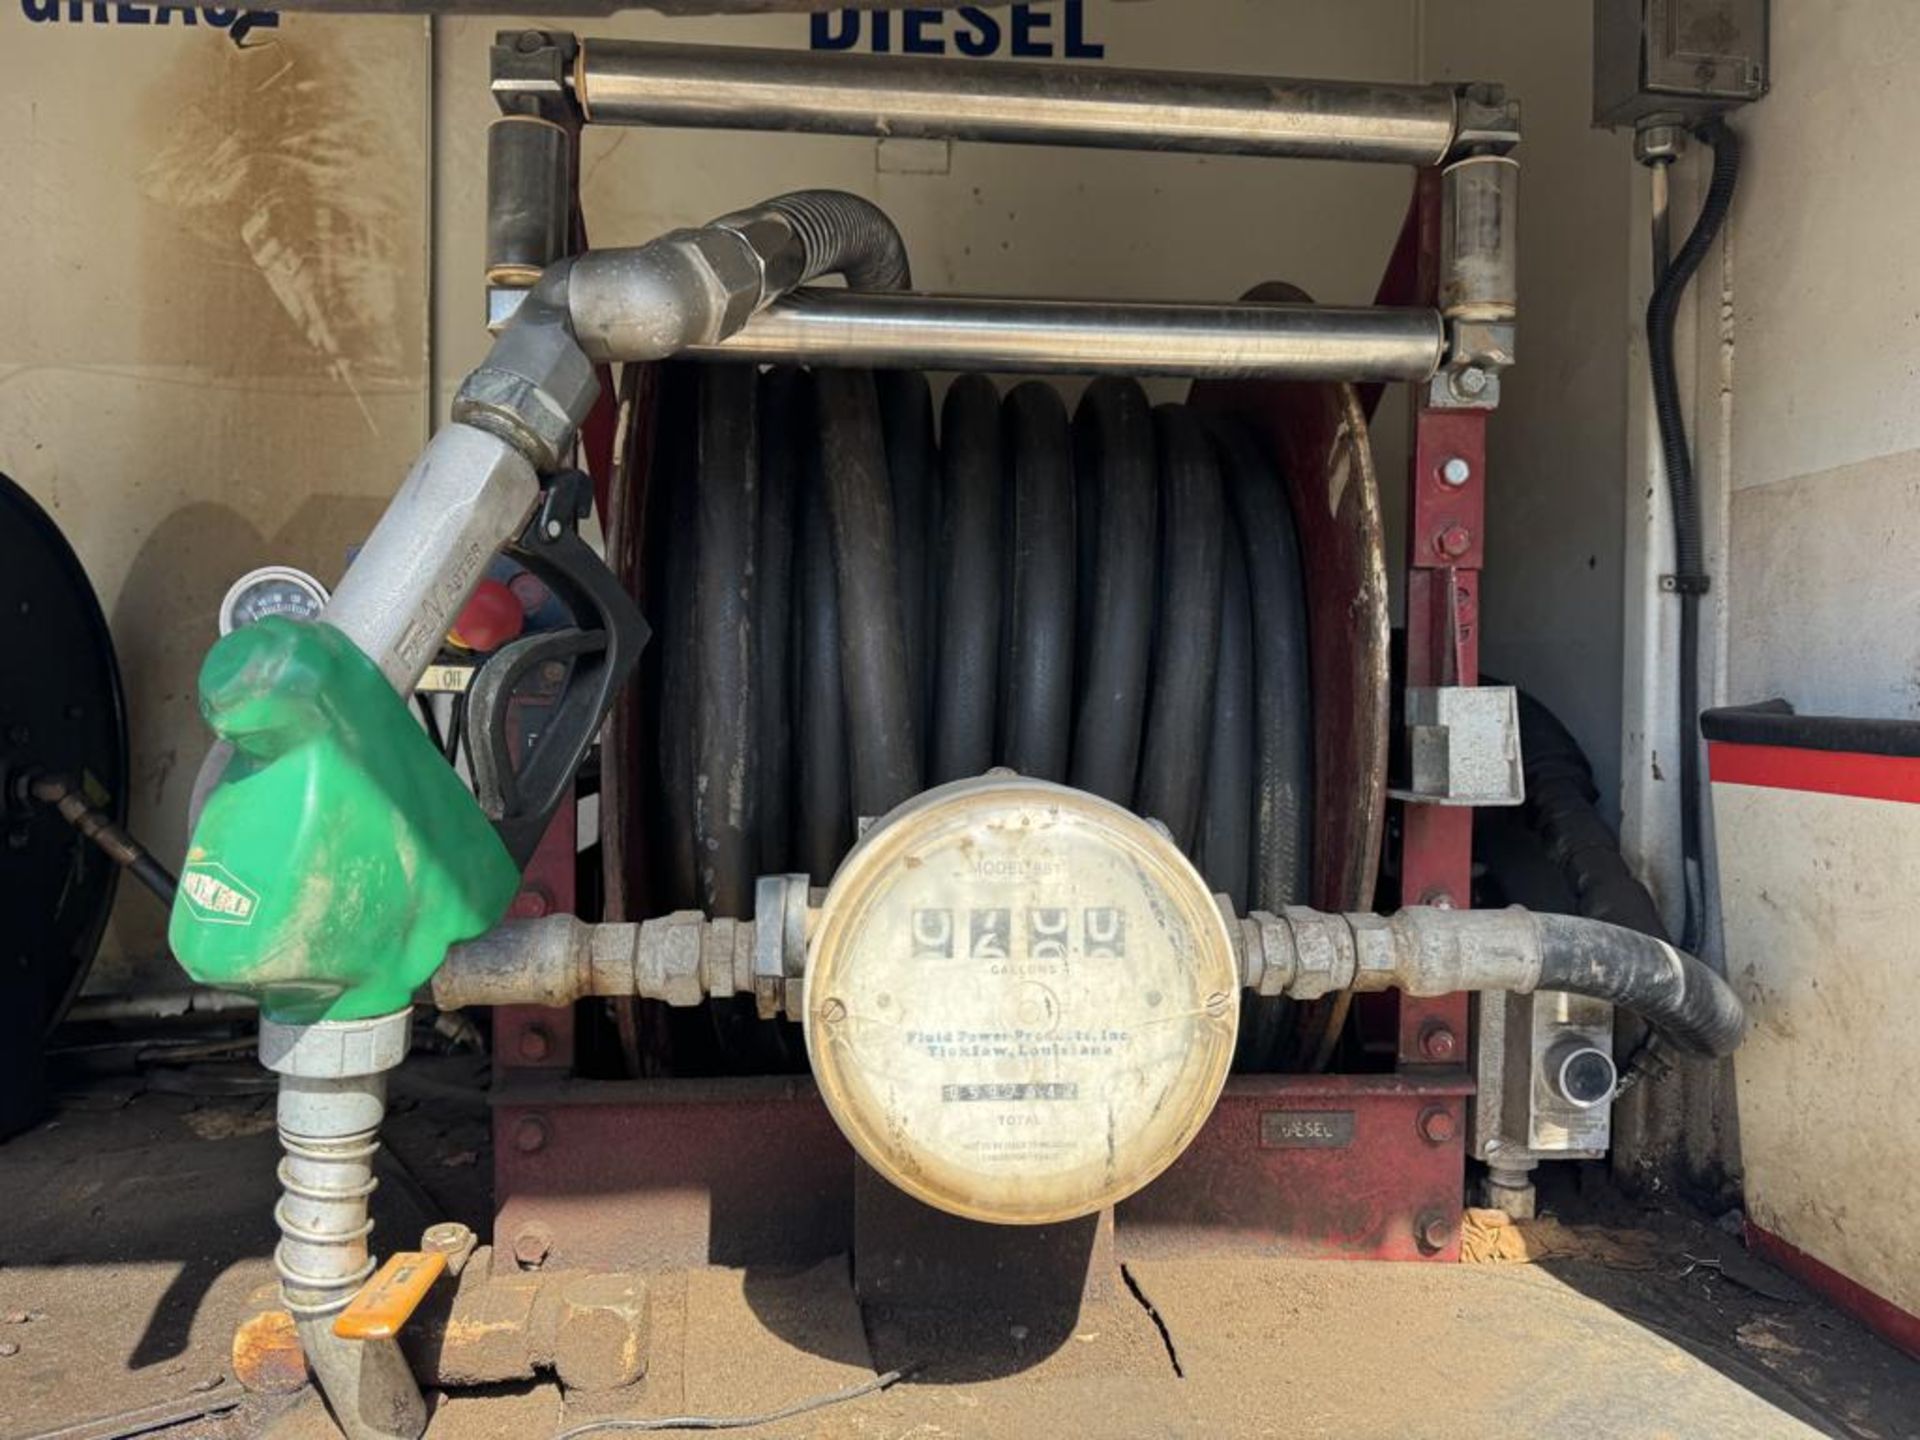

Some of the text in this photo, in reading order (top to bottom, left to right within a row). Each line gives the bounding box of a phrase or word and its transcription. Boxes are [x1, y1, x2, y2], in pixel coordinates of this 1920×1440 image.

[810, 1, 1104, 59] DIESEL
[990, 964, 1057, 976] GALLONS
[906, 1030, 953, 1043] Fluid
[957, 1030, 1008, 1043] Power
[997, 1114, 1043, 1127] TOTAL
